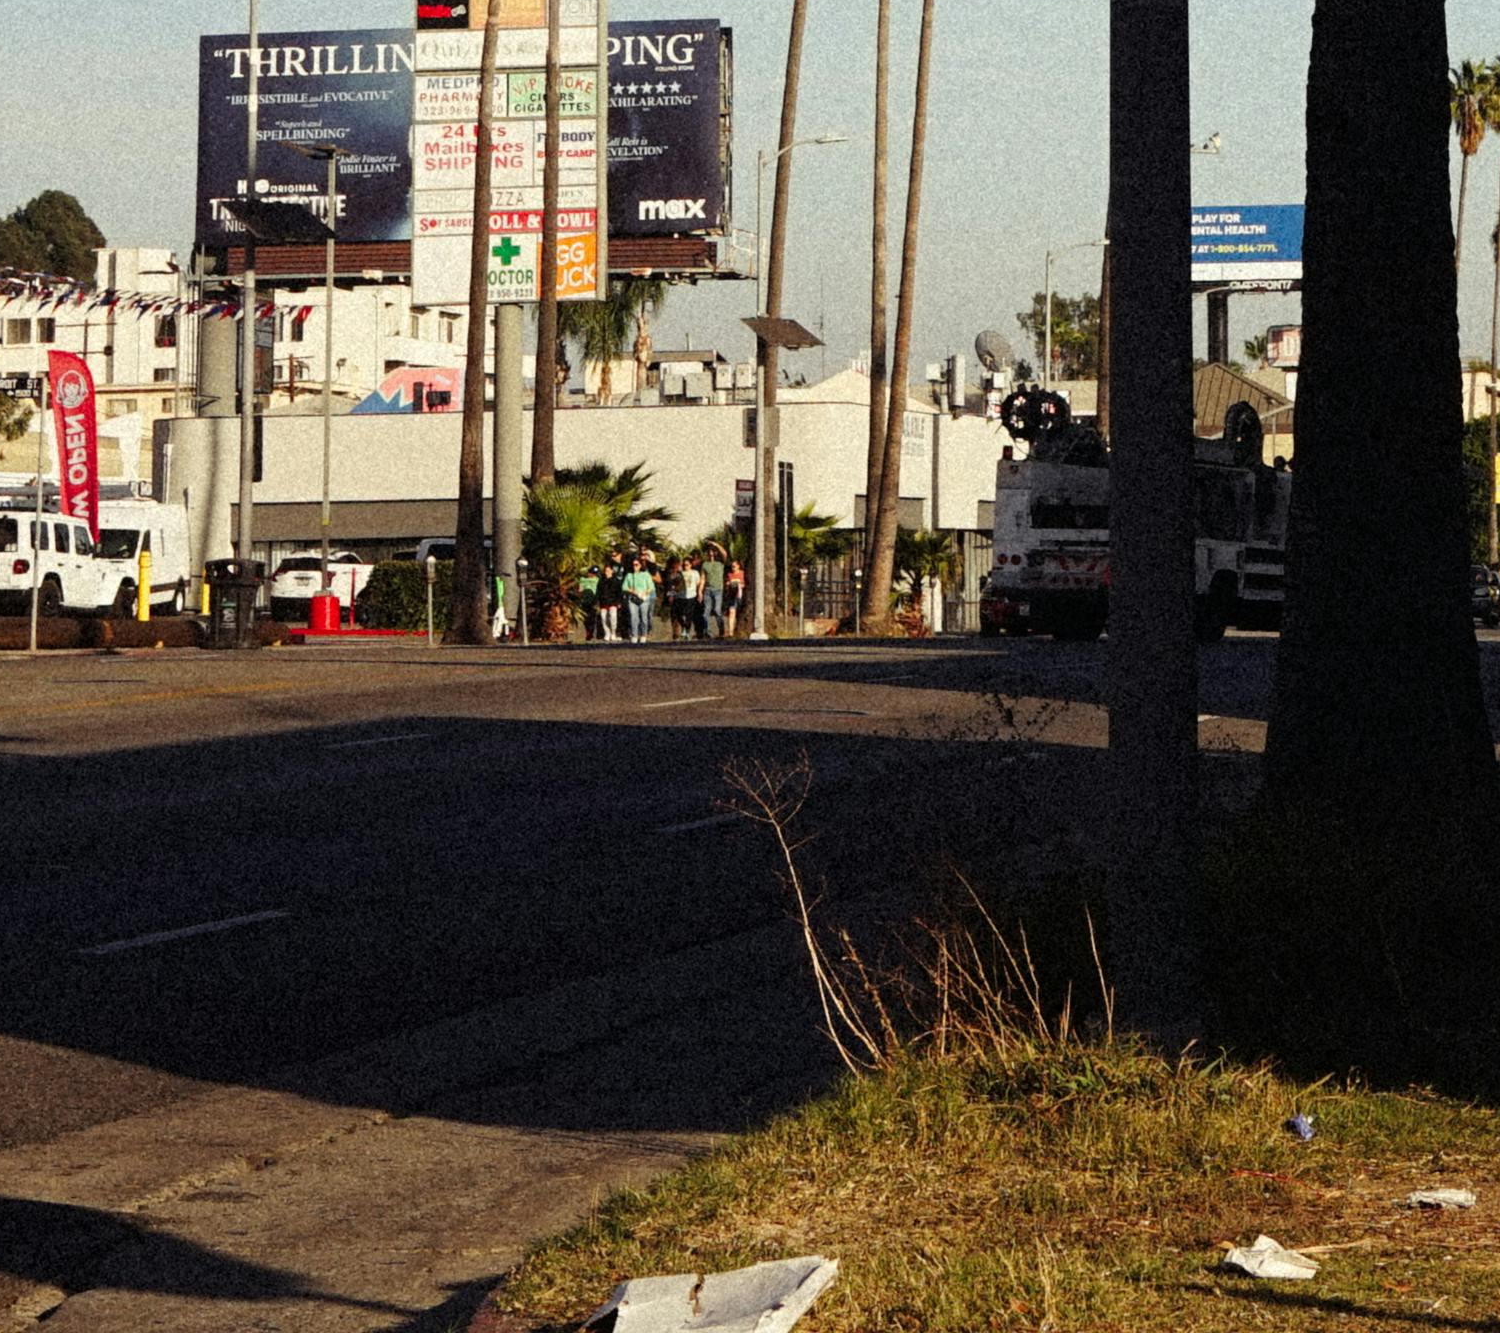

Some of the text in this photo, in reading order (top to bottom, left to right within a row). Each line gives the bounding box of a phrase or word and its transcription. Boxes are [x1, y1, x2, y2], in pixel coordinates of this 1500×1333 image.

[226, 93, 308, 105] “IRRSISTIBLE
[420, 91, 504, 102] PHARMAY
[530, 92, 575, 102] CIRS
[608, 94, 698, 108] XHILARATING”
[514, 102, 591, 113] CIGATTES
[442, 124, 465, 139] 24
[561, 131, 596, 142] BODY
[425, 141, 525, 155] Mailbxes
[425, 155, 524, 171] SHIPNG
[237, 179, 319, 194] HO ORIGINAL
[495, 191, 525, 207] ZZA
[638, 199, 706, 221] max
[488, 214, 522, 230] OLL
[557, 213, 595, 228] OWL
[1192, 214, 1218, 224] PLAY
[556, 241, 586, 266] GG
[487, 269, 534, 286] OCTOR
[556, 262, 596, 291] UCK
